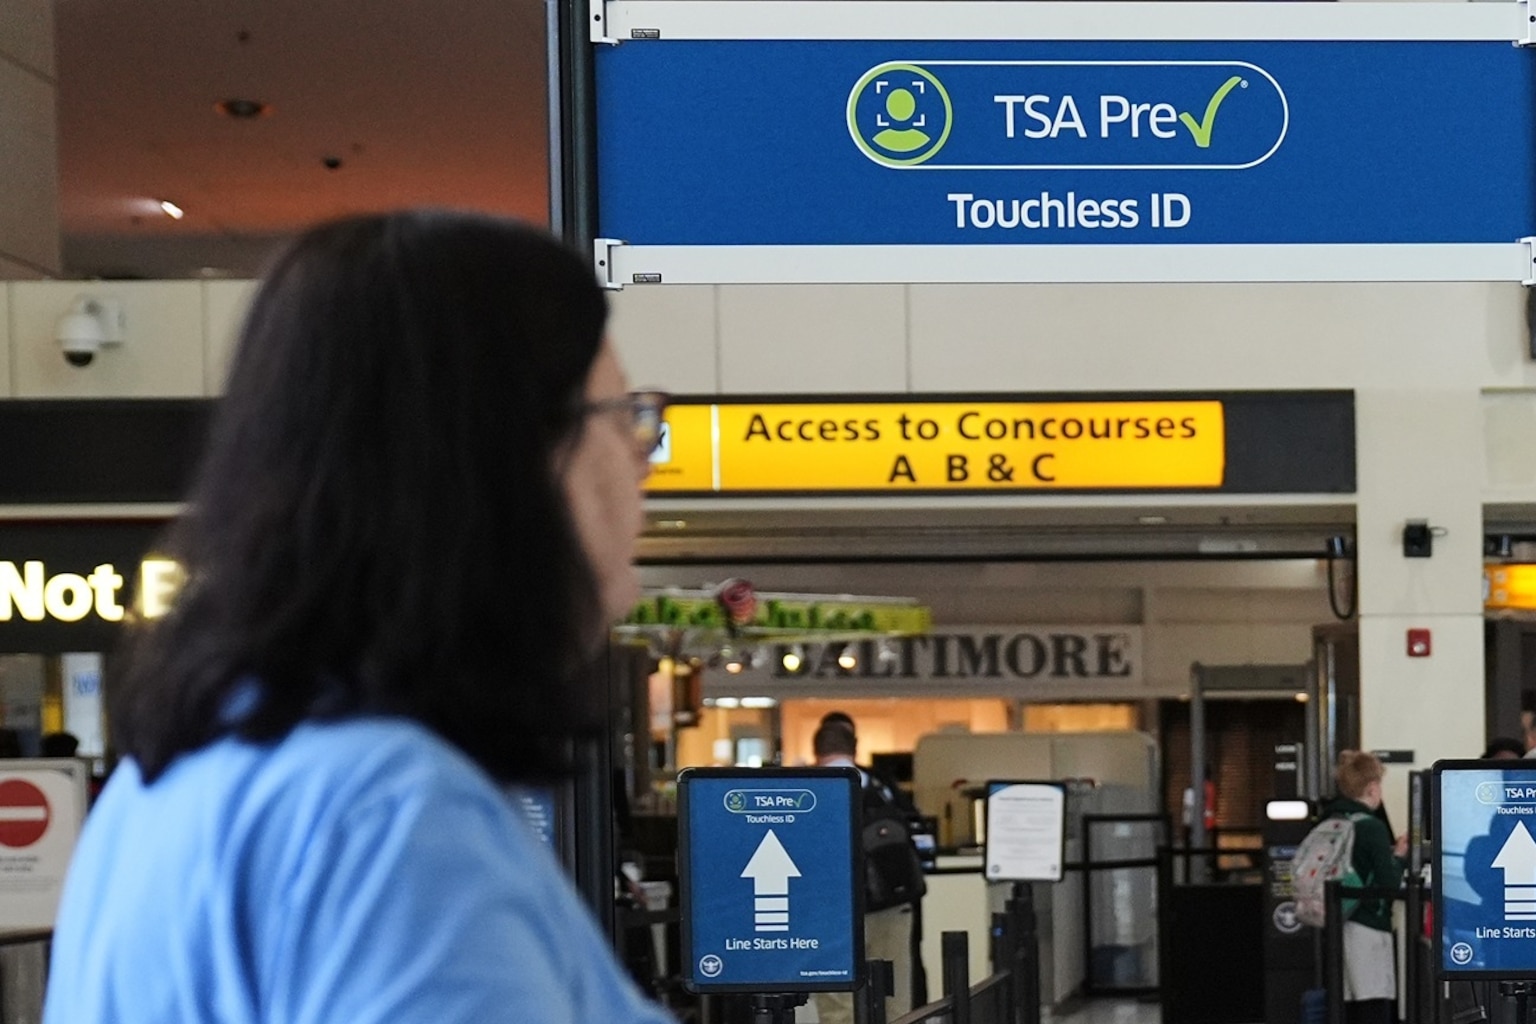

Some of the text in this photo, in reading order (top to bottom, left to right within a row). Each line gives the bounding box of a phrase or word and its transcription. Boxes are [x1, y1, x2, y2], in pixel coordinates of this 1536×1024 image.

[994, 95, 1087, 138] TSA
[1101, 95, 1178, 138] Pre
[948, 192, 1190, 229] Touchless ID
[745, 412, 1197, 442] Access to Concourses
[888, 453, 1056, 483] A B & C
[0, 560, 124, 621] Not
[1505, 788, 1524, 798] TSA
[755, 796, 774, 807] TSA
[1496, 806, 1533, 815] Touchless
[746, 814, 795, 823] Touchless ID
[1476, 926, 1500, 939] Line
[1503, 926, 1536, 939] Starts
[725, 937, 819, 950] Line Starts Here
